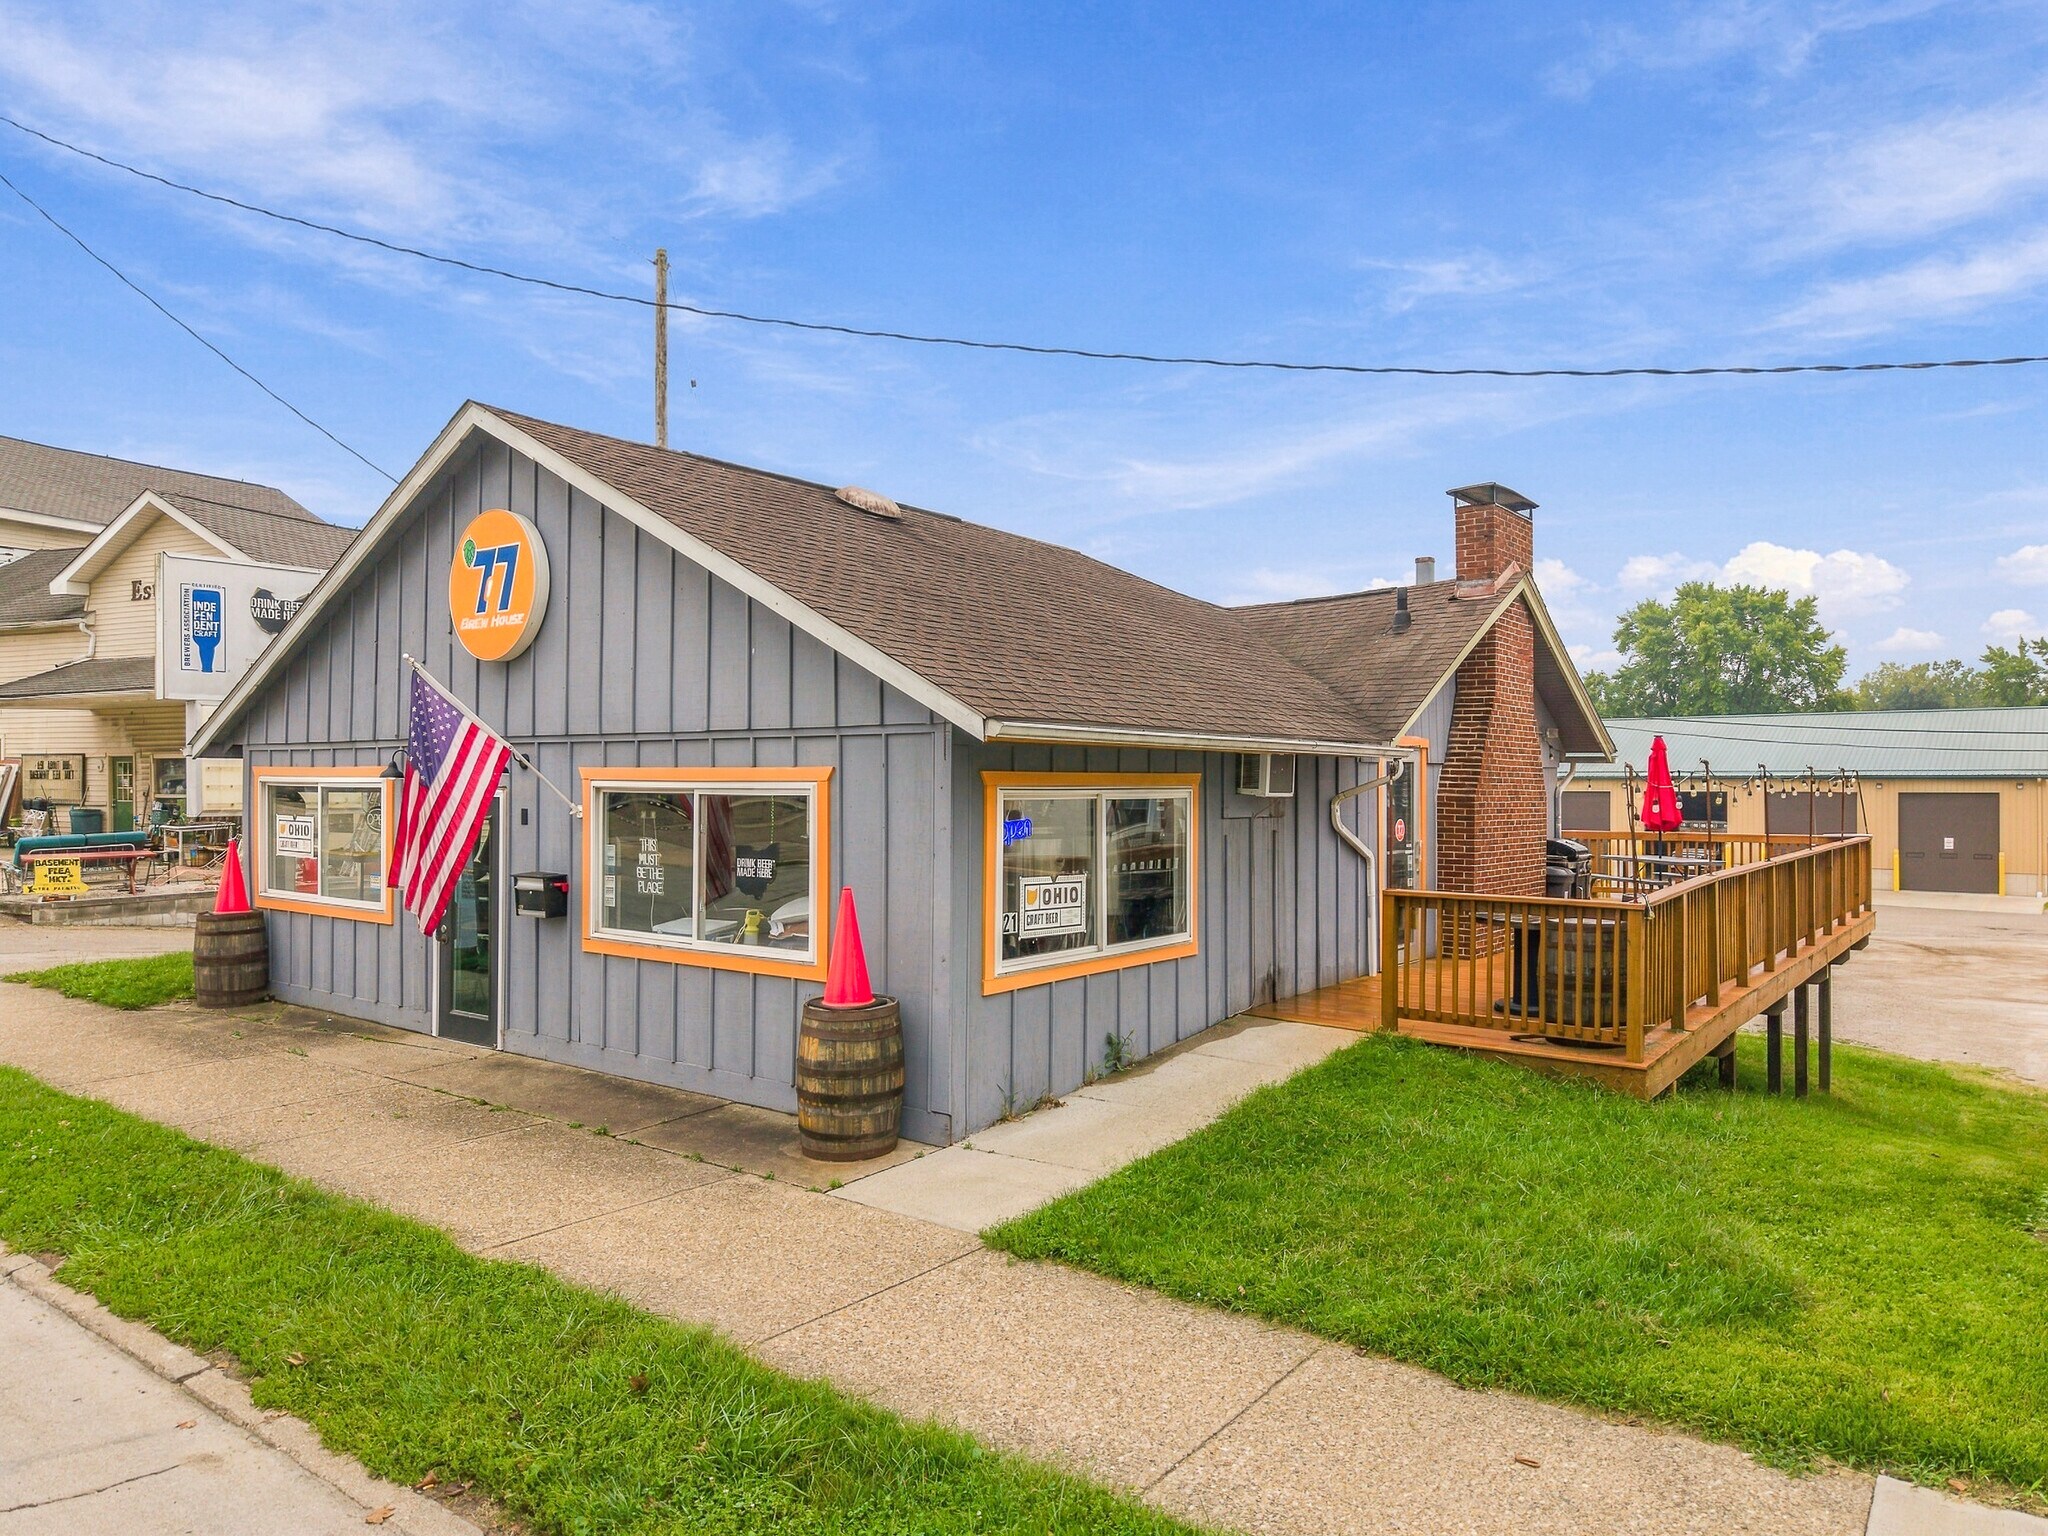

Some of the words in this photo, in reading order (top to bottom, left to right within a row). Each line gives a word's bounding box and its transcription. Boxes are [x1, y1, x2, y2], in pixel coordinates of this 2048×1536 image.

[472, 543, 521, 615] 77
[194, 601, 217, 612] INDE
[251, 597, 281, 610] DRINK
[284, 600, 303, 611] BEE
[194, 611, 213, 621] PEN
[251, 608, 281, 619] MADE
[194, 620, 220, 631] DENT
[194, 630, 218, 638] CRAFT
[288, 823, 310, 836] OHIO
[640, 837, 657, 852] THIS
[35, 859, 80, 867] BASEMENT
[638, 853, 661, 866] MUST
[736, 857, 756, 868] DRINK
[757, 858, 773, 869] BEER
[48, 867, 71, 875] FLEA
[736, 868, 756, 878] MADE
[757, 868, 773, 879] HERE
[637, 880, 664, 895] PLACE
[1042, 886, 1079, 906] OHIO
[1026, 913, 1044, 926] CRAFT
[1045, 912, 1059, 925] BEER
